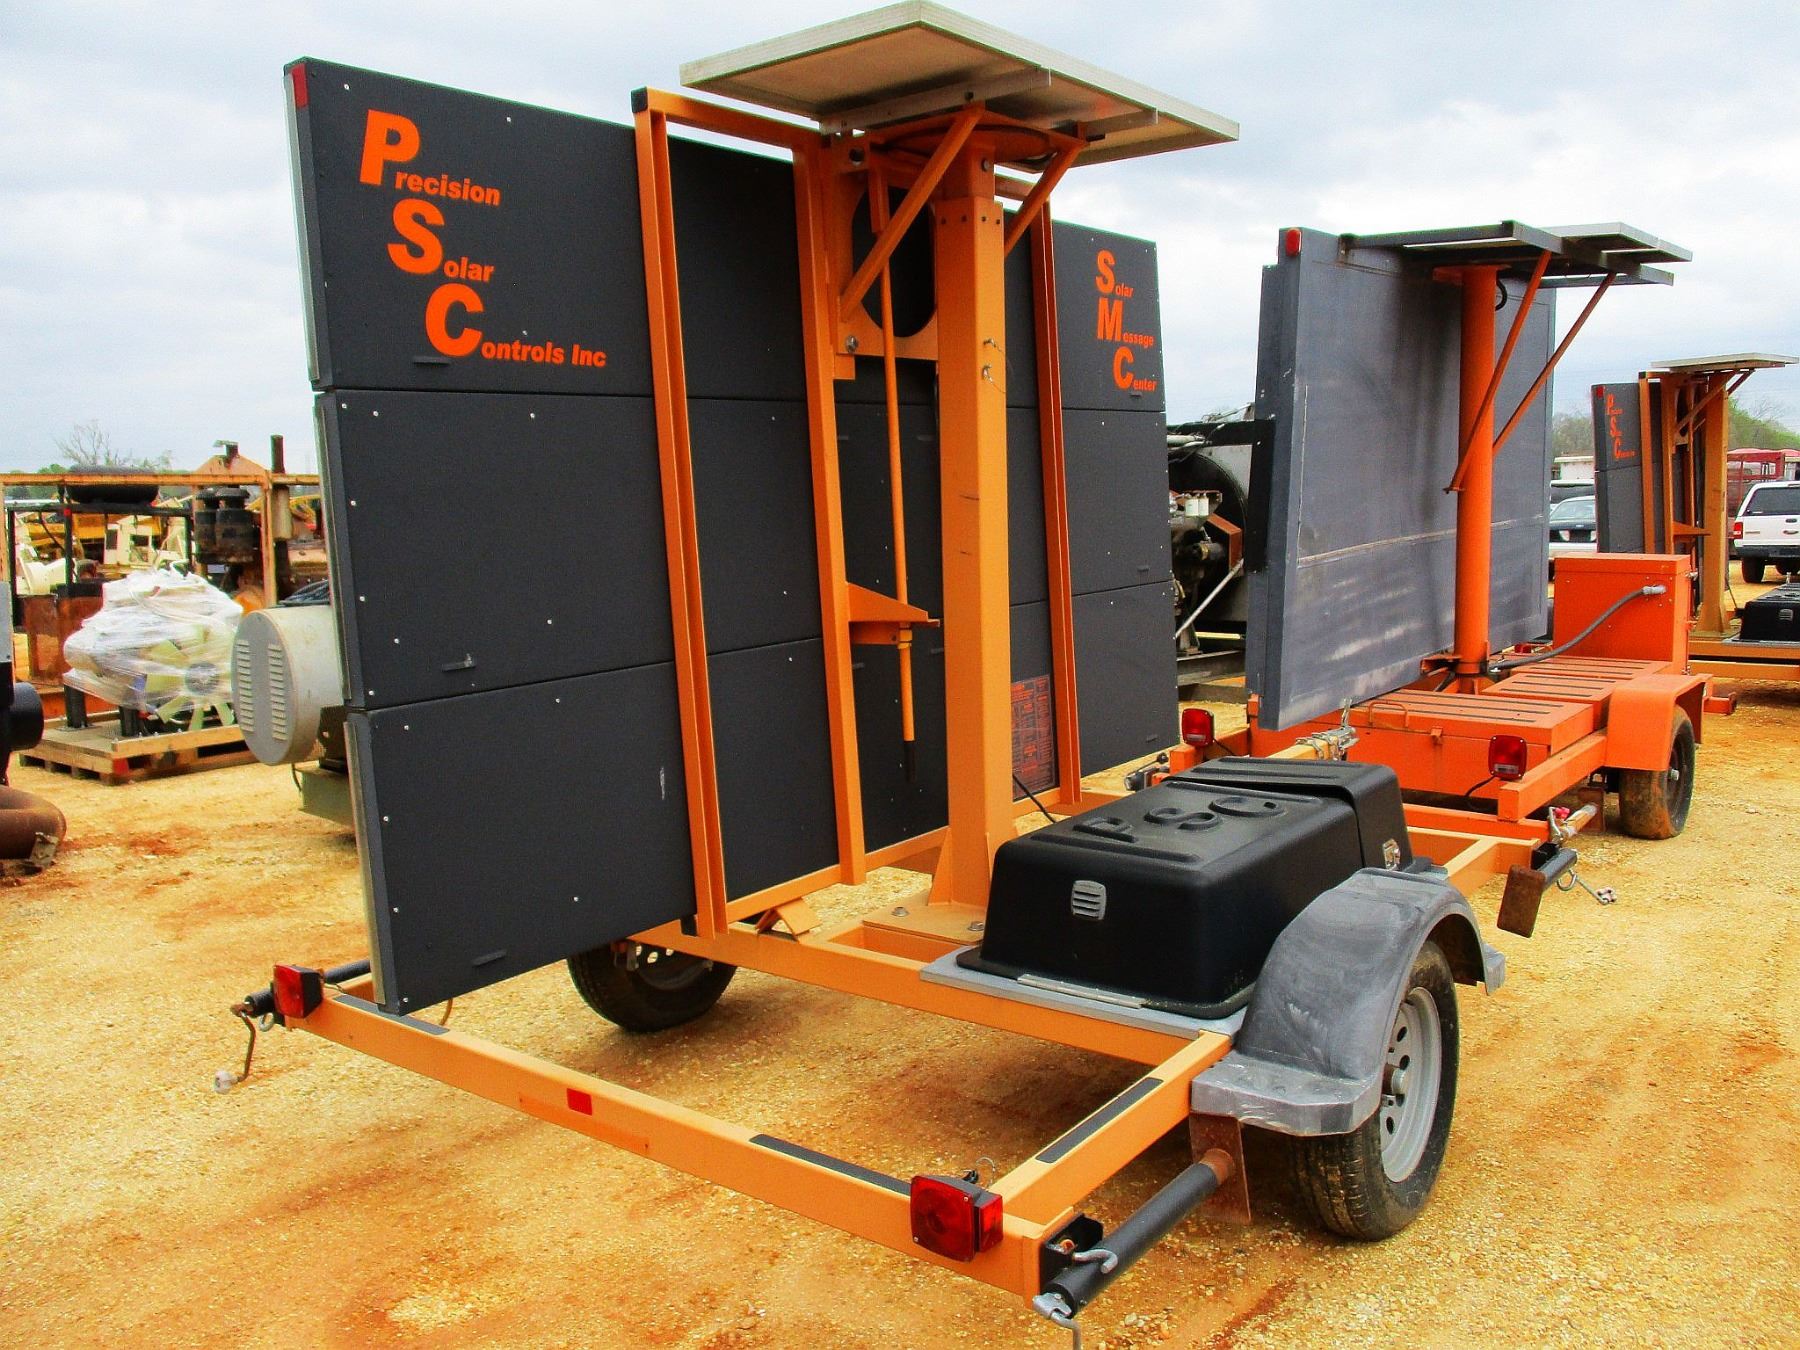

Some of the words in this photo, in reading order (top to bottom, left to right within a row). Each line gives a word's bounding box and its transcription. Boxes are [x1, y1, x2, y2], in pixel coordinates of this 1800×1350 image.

[360, 109, 502, 207] Precision
[387, 198, 495, 283] Solar
[1095, 250, 1134, 298] Solar
[425, 283, 566, 365] Controls
[572, 344, 607, 368] Inc
[1096, 297, 1154, 348] Message
[1112, 347, 1157, 392] Center
